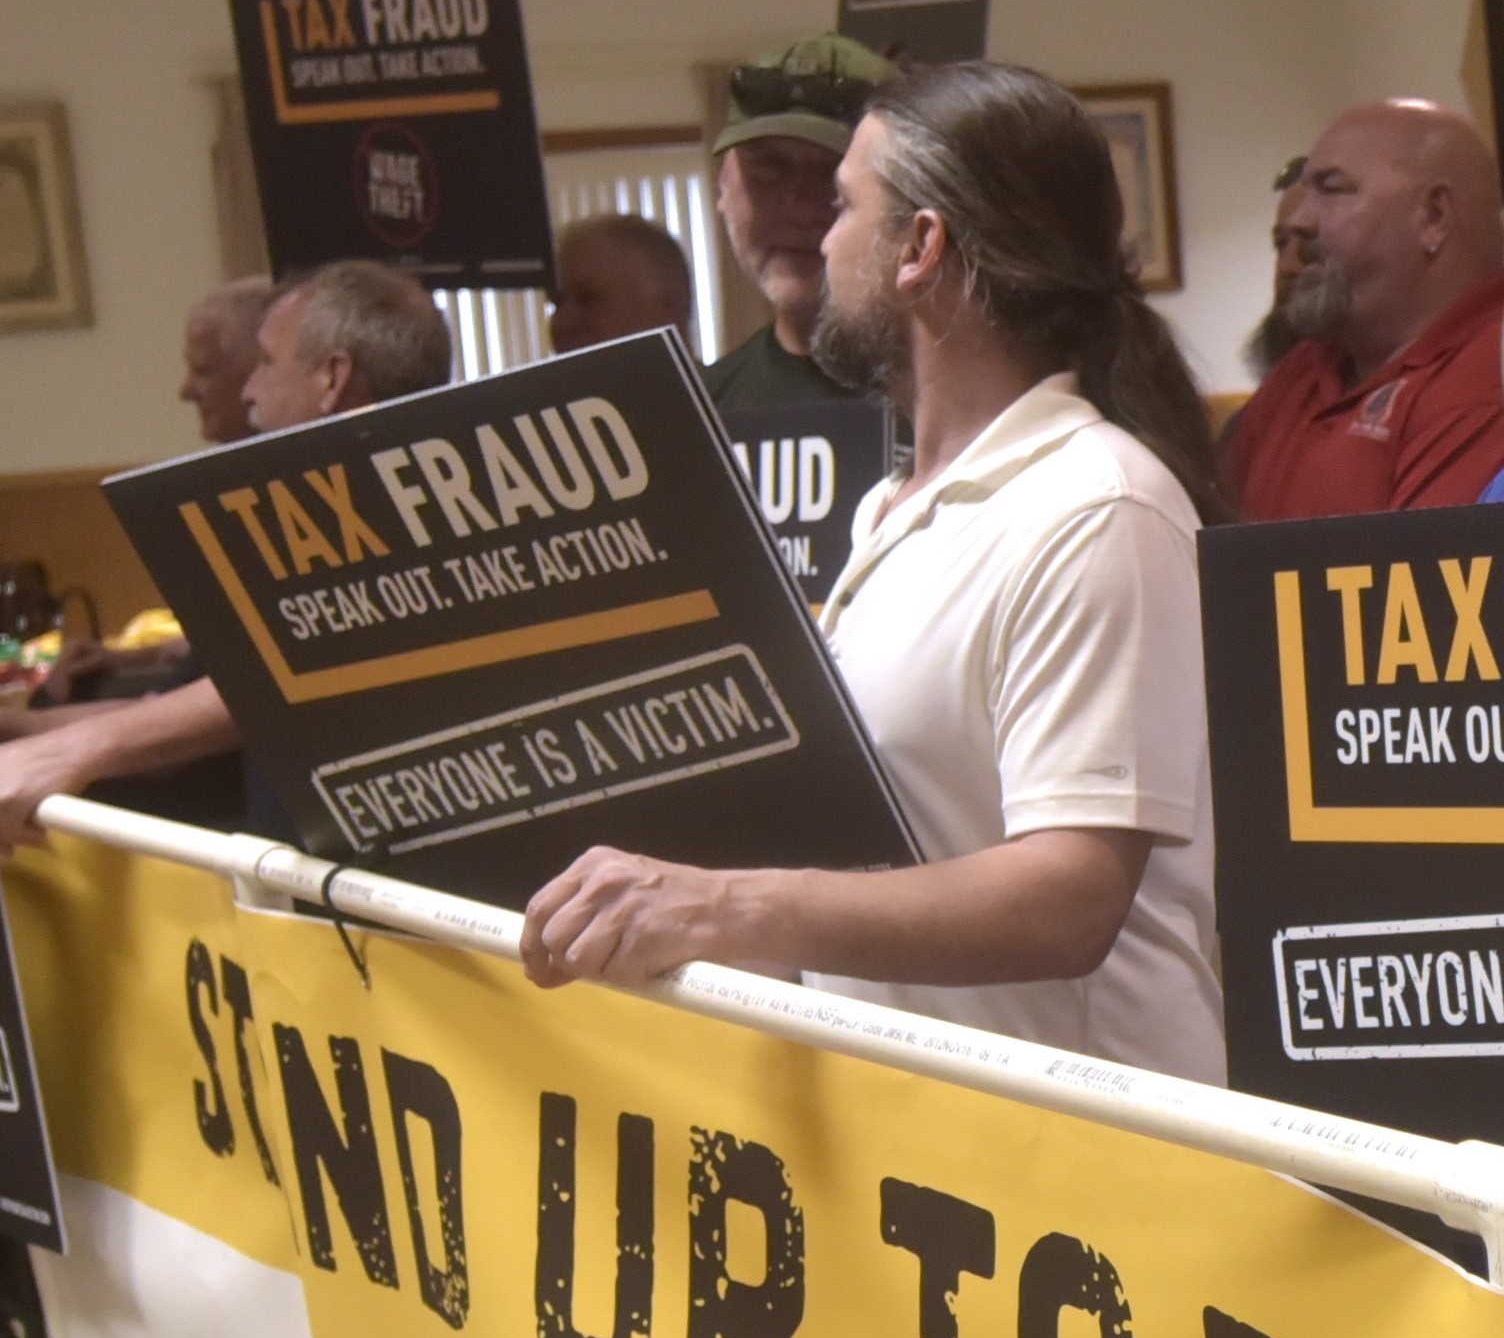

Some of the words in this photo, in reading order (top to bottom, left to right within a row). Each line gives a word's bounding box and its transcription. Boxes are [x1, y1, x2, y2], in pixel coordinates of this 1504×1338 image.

[217, 463, 391, 581] TAX
[370, 396, 650, 548] FRAUD
[278, 582, 385, 641] SPEAK
[377, 566, 453, 619] OUT.
[444, 545, 536, 603] TAKE
[531, 517, 669, 588] ACTION.
[1326, 554, 1502, 687] TAX
[335, 743, 532, 839] EVERYONE
[522, 728, 577, 789] IS
[575, 718, 618, 776] A
[604, 675, 775, 764] VICTIM.
[1335, 703, 1457, 765] SPEAK
[185, 937, 470, 1331] STND
